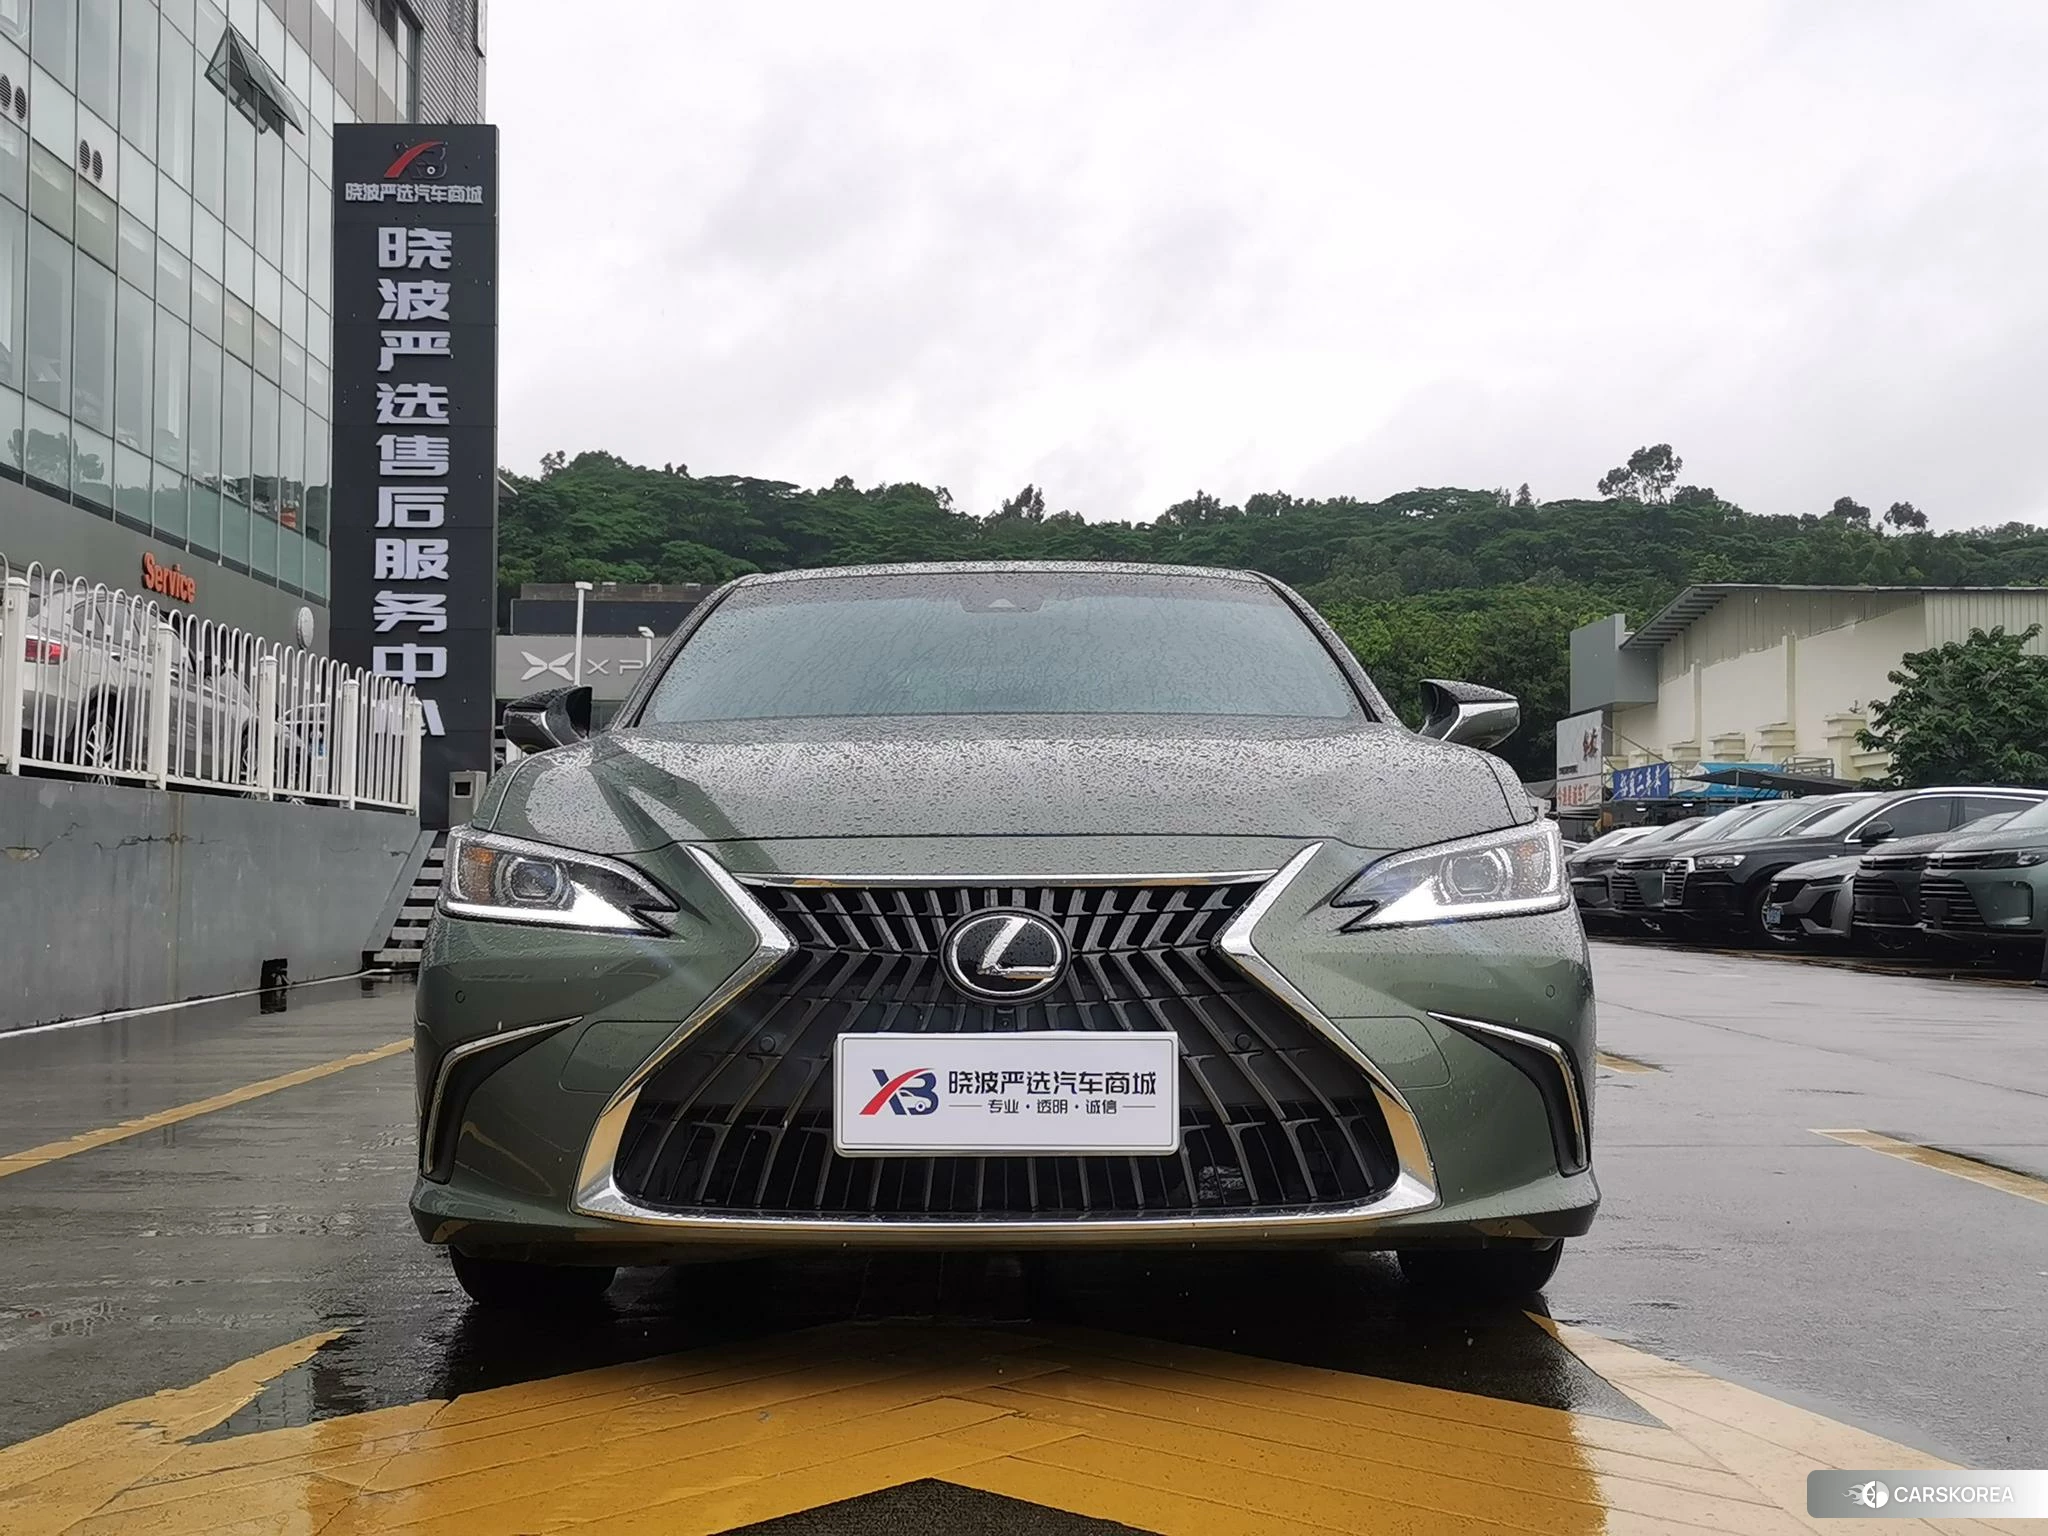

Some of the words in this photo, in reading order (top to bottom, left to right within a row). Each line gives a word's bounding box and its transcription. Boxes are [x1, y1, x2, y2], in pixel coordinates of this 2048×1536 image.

[344, 182, 484, 205] 晓波严选汽车商城
[142, 551, 197, 604] Service
[949, 1071, 1157, 1095] 晓波严选汽车商城
